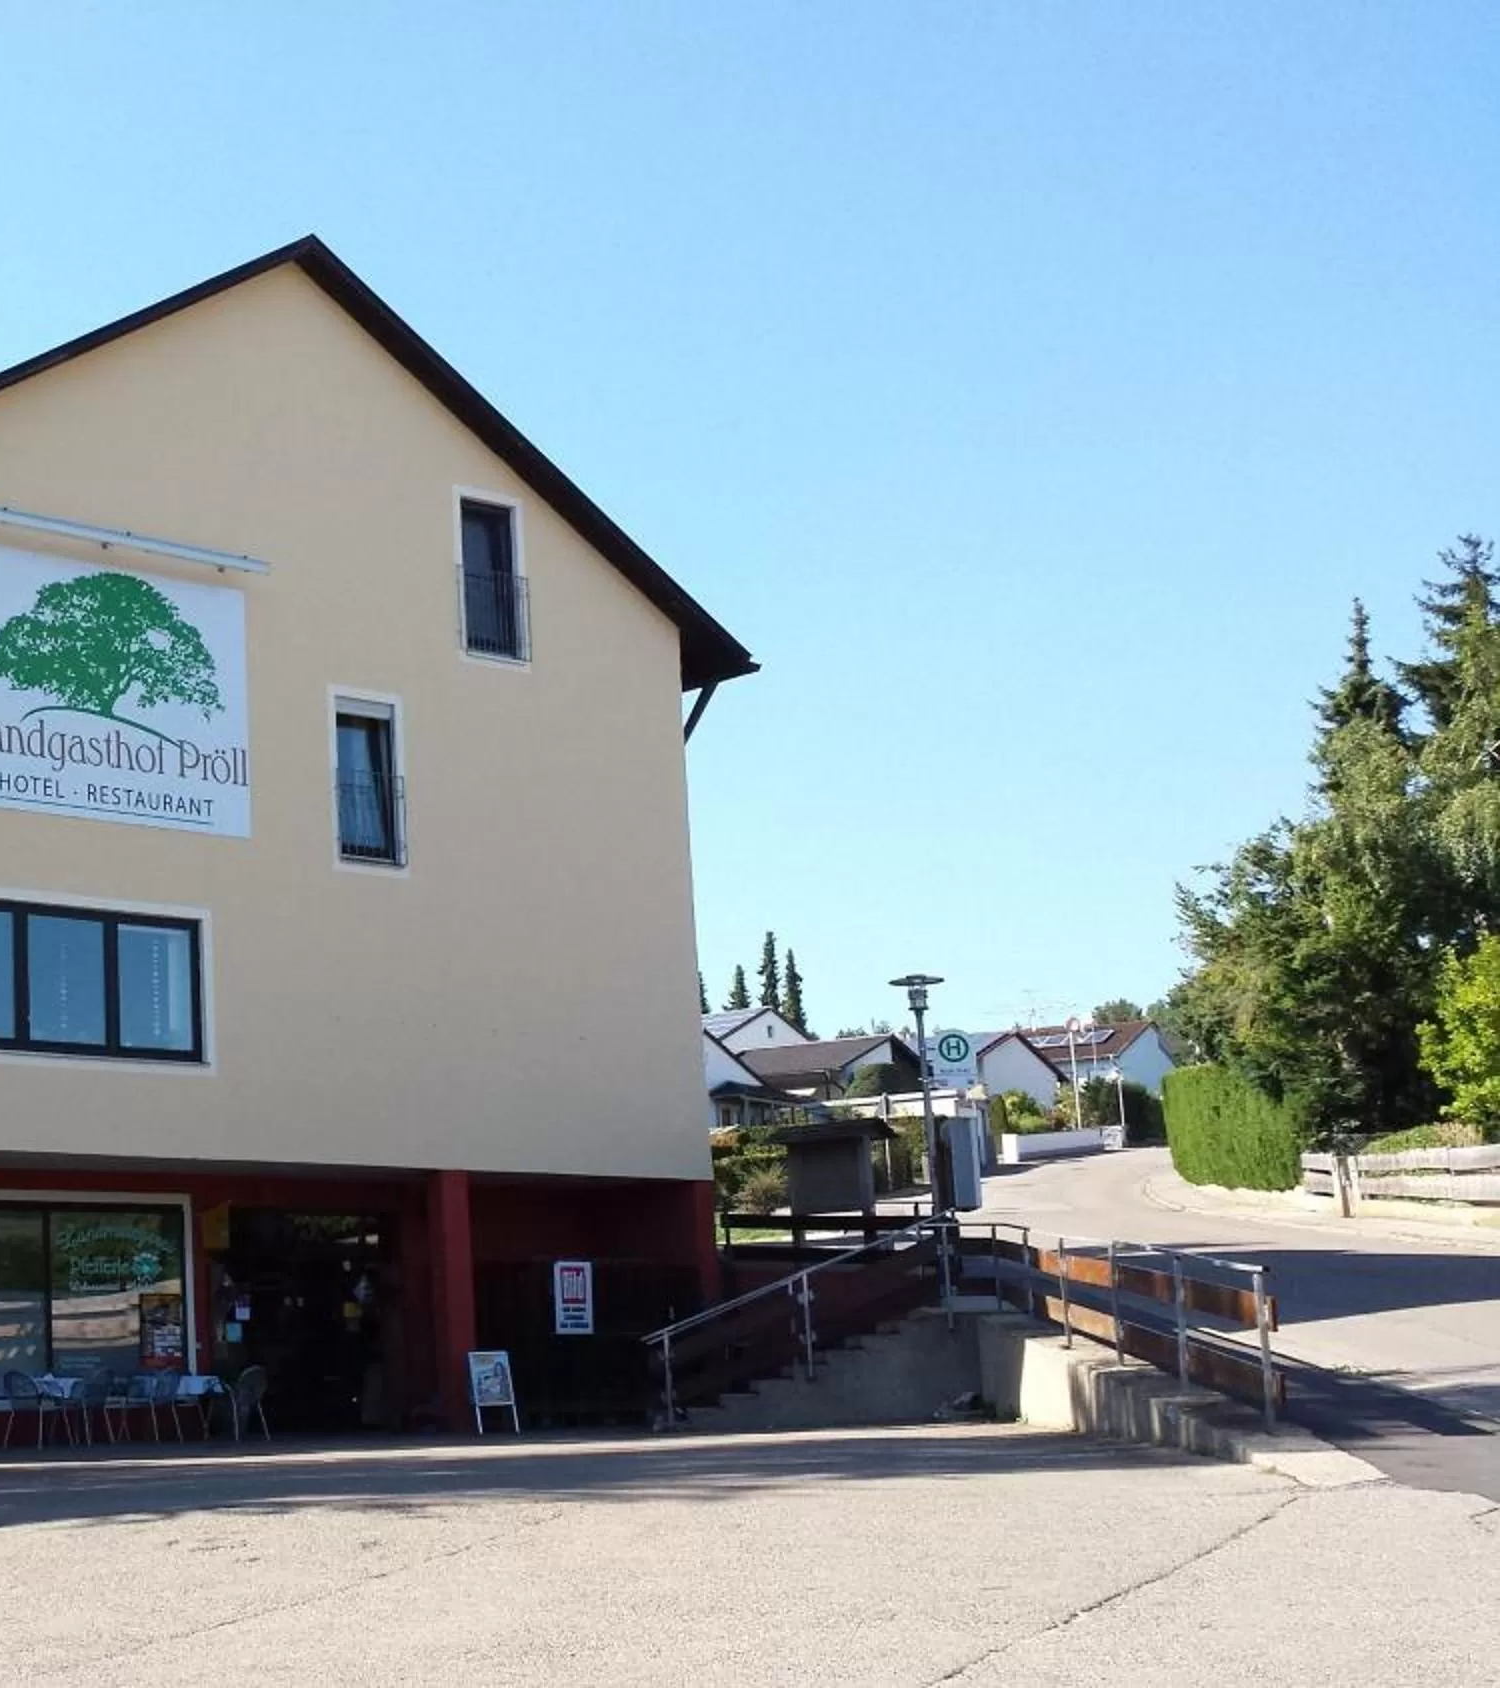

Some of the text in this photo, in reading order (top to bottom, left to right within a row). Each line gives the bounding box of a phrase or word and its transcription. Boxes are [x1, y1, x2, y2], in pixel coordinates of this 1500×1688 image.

[179, 739, 249, 786] Pröll
[0, 773, 65, 799] HOTEL
[87, 784, 214, 816] RESTAURANT
[946, 1040, 961, 1056] H
